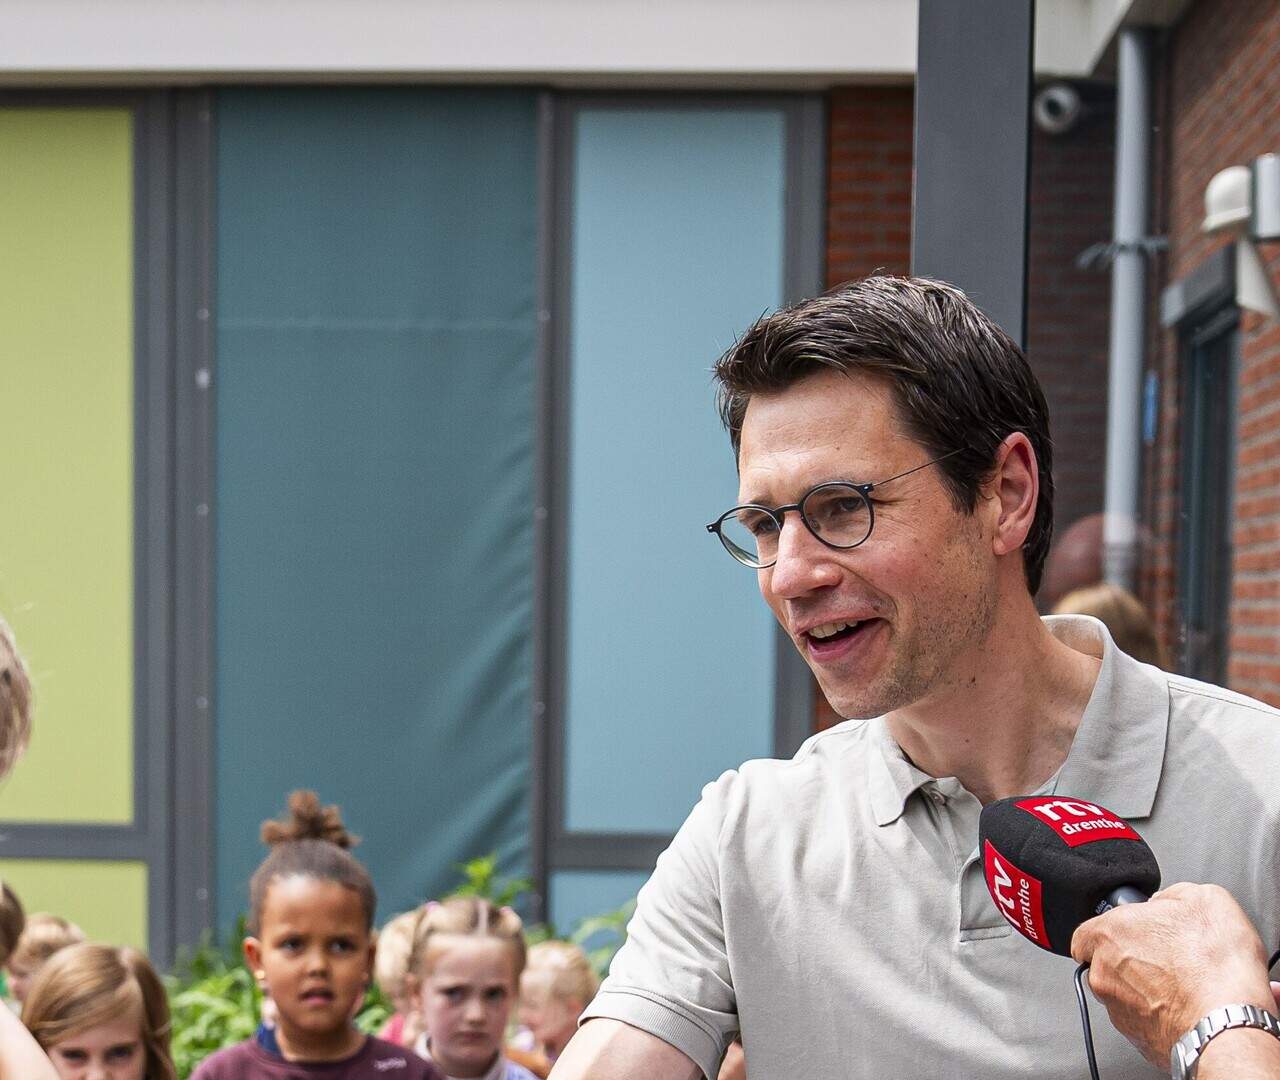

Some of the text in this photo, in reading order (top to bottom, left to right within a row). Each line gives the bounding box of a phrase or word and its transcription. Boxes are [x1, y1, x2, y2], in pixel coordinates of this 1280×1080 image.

[1033, 801, 1104, 821] rtv
[1061, 818, 1126, 835] drenthe
[993, 857, 1021, 928] rtv
[1018, 878, 1039, 940] drenthe
